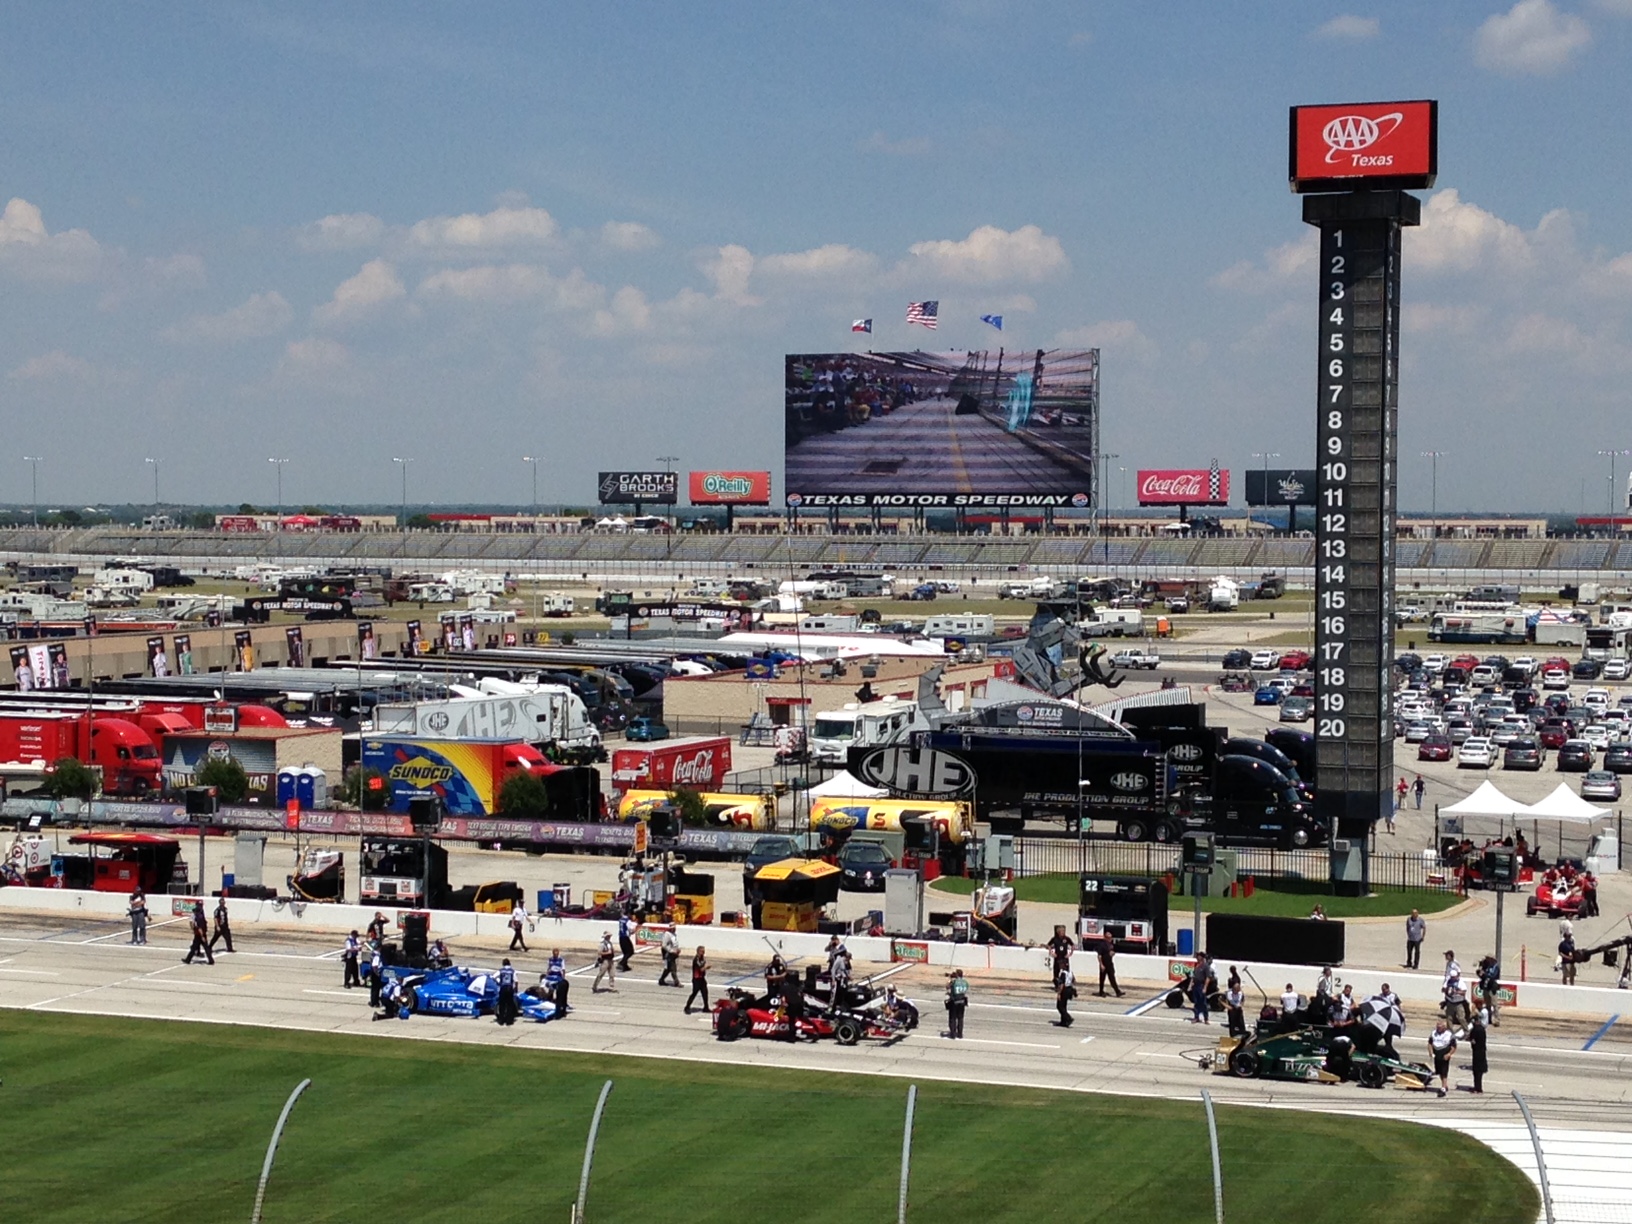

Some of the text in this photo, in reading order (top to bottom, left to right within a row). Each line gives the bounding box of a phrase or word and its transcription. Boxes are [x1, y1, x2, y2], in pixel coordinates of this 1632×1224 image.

[1329, 116, 1373, 149] AAA
[1351, 153, 1393, 167] Texas
[1334, 230, 1343, 248] 1
[1331, 256, 1345, 274] 2
[1331, 282, 1345, 300] 3
[1329, 307, 1344, 326] 4
[1329, 333, 1344, 352] 5
[1329, 359, 1343, 378] 6
[1329, 385, 1343, 403] 7
[1328, 411, 1342, 429] 8
[1327, 437, 1342, 455] 9
[619, 474, 674, 484] GARTH
[1322, 463, 1347, 481] 10
[619, 483, 674, 492] BROOKS
[705, 474, 752, 494] O'Reilly
[1142, 474, 1204, 496] Coca-Cola
[802, 495, 1068, 505] TEXAS MOTOR SPEEDWAY
[1323, 488, 1343, 507] 11
[1322, 513, 1346, 532] 12
[1321, 539, 1346, 558] 13
[1321, 565, 1346, 583] 14
[263, 601, 333, 610] TEXAS MOTOR SPEEDWAY
[1321, 591, 1346, 609] 15
[650, 608, 728, 618] TEXAS MOTOR SPEEDWAY
[1321, 616, 1345, 635] 16
[1321, 642, 1345, 660] 17
[1320, 667, 1345, 686] 18
[1320, 693, 1345, 712] 19
[431, 712, 449, 727] JHE
[1034, 707, 1063, 717] TEXAS
[1319, 718, 1345, 737] 20
[1172, 744, 1199, 759] JHE
[391, 765, 452, 780] SUNOCO
[869, 747, 961, 792] JHE
[1115, 772, 1144, 789] JHE
[1043, 793, 1109, 803] PRODUCTION
[1112, 796, 1150, 805] GROUP
[307, 815, 334, 825] TEXAS
[440, 821, 458, 831] XAS
[820, 815, 858, 826] SUNOCO
[556, 827, 584, 837] TEXAS
[689, 834, 718, 844] TEXAS
[1085, 880, 1098, 891] 22
